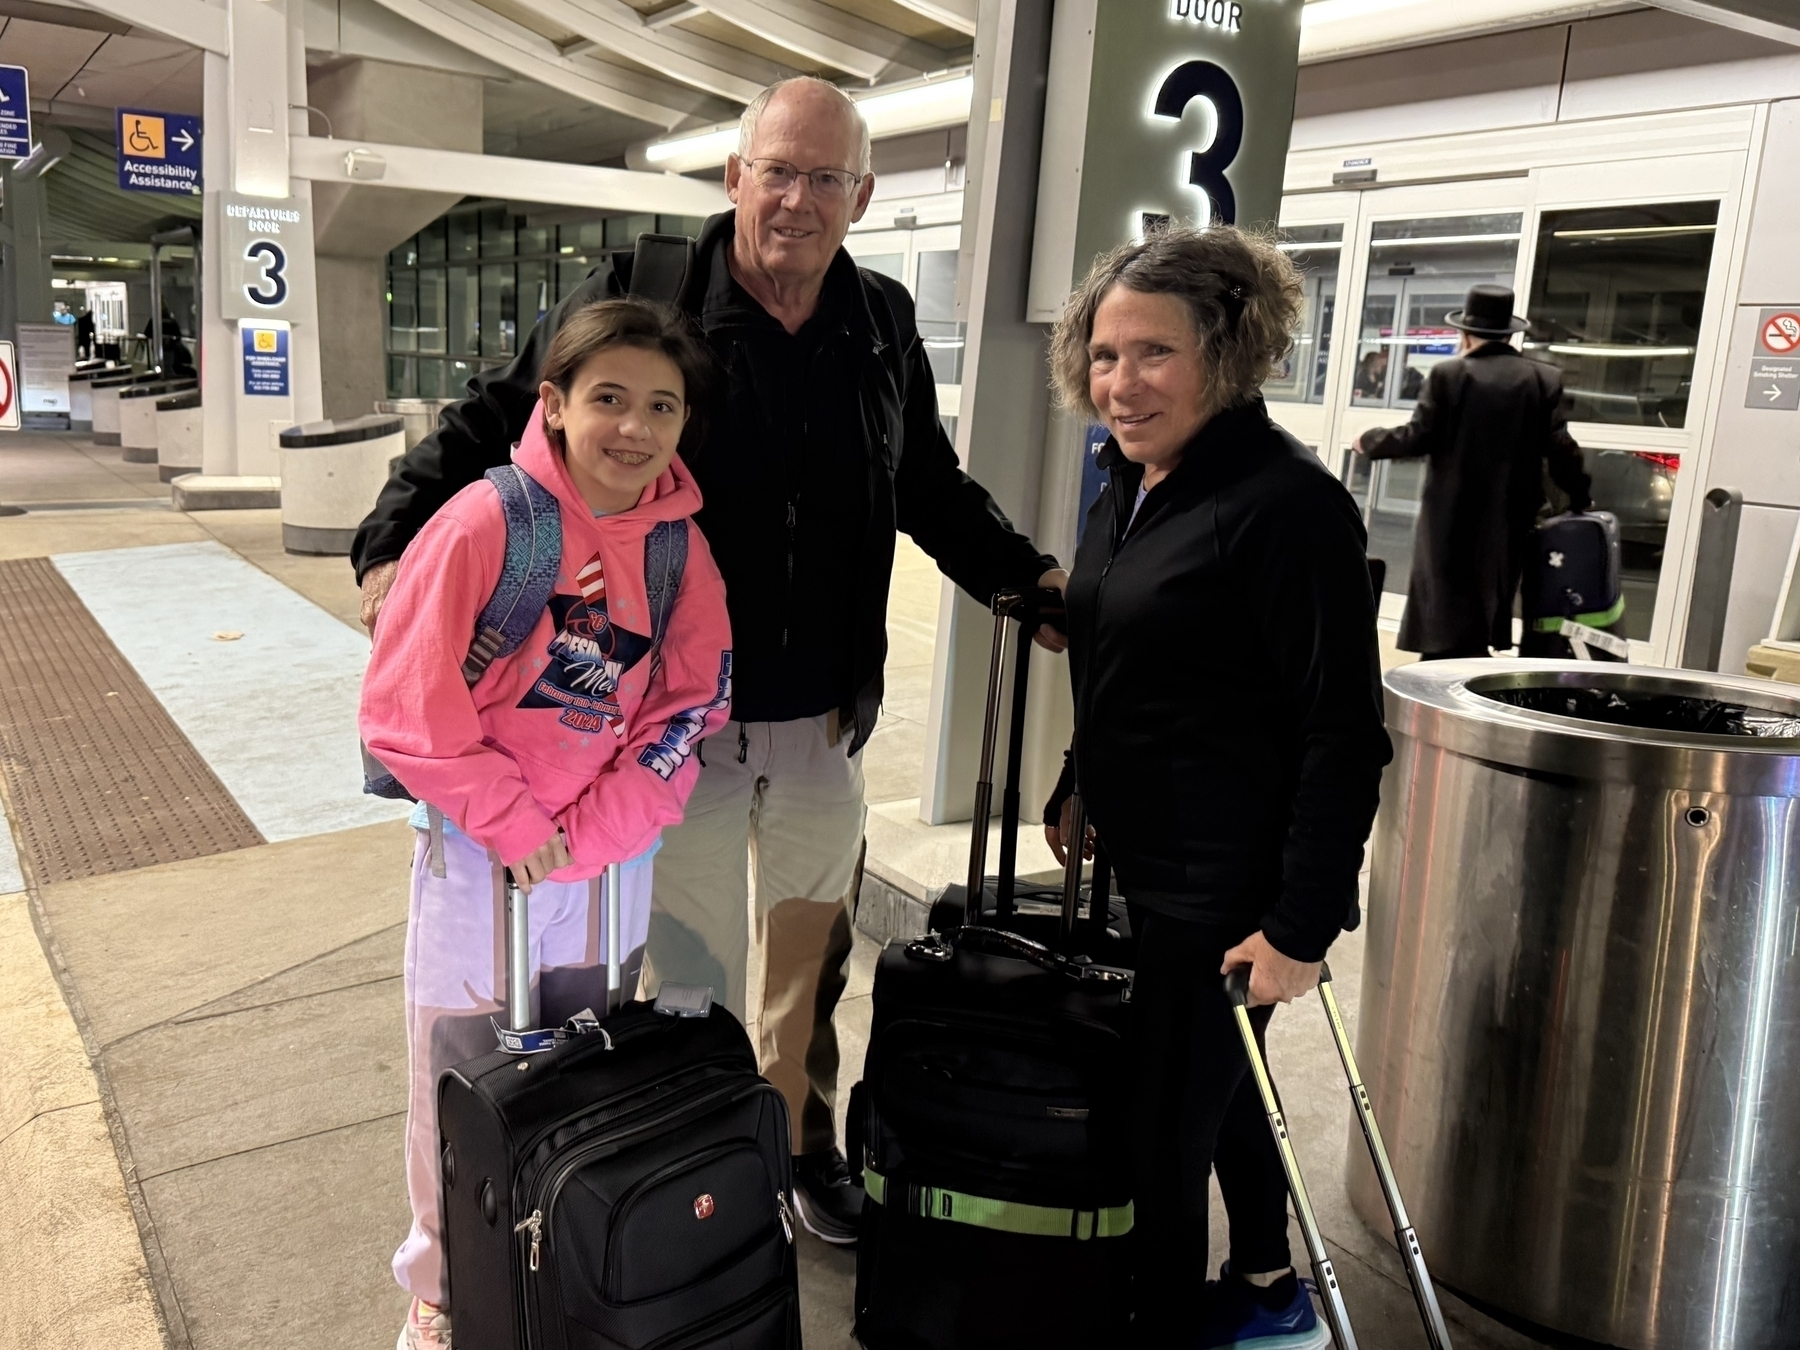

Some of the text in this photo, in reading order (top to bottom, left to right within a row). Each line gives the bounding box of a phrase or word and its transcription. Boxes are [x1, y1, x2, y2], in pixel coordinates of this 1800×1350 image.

[1170, 0, 1242, 32] DOOR
[1142, 59, 1244, 240] 3
[124, 160, 198, 181] Accessibility
[129, 173, 193, 190] Assistance
[226, 204, 300, 223] DEPARTURES
[248, 219, 281, 234] DOOR
[245, 240, 288, 307] 3
[538, 681, 575, 705] February
[562, 708, 602, 732] 2024
